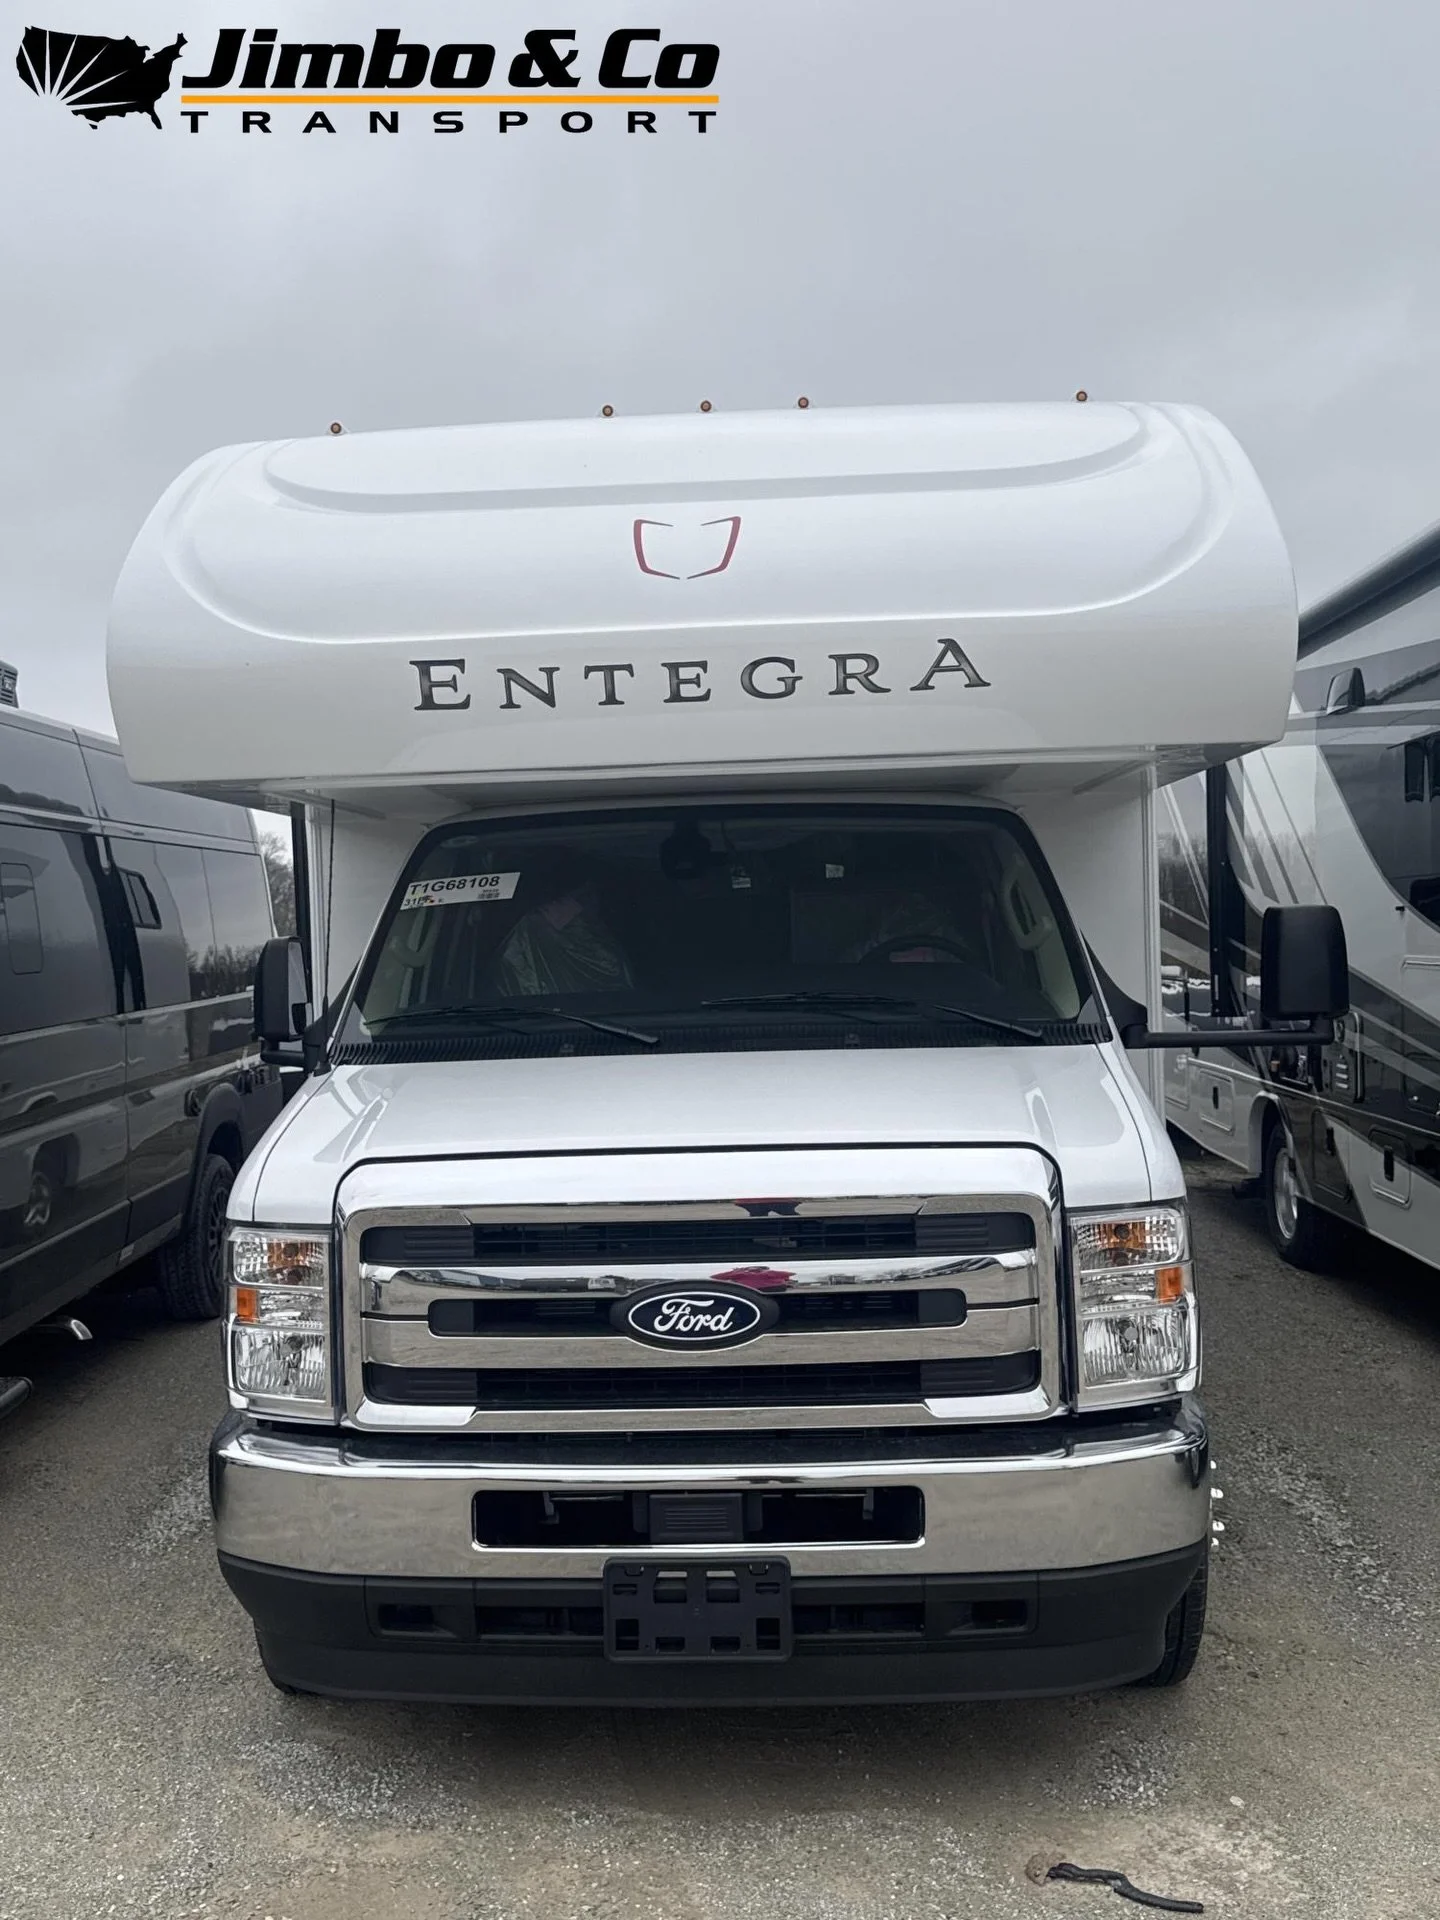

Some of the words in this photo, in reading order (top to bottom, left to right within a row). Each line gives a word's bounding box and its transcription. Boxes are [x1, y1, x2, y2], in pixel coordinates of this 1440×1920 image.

[409, 638, 992, 711] ENTEGRA
[410, 876, 501, 896] T1G68108
[653, 1298, 735, 1332] Ford
